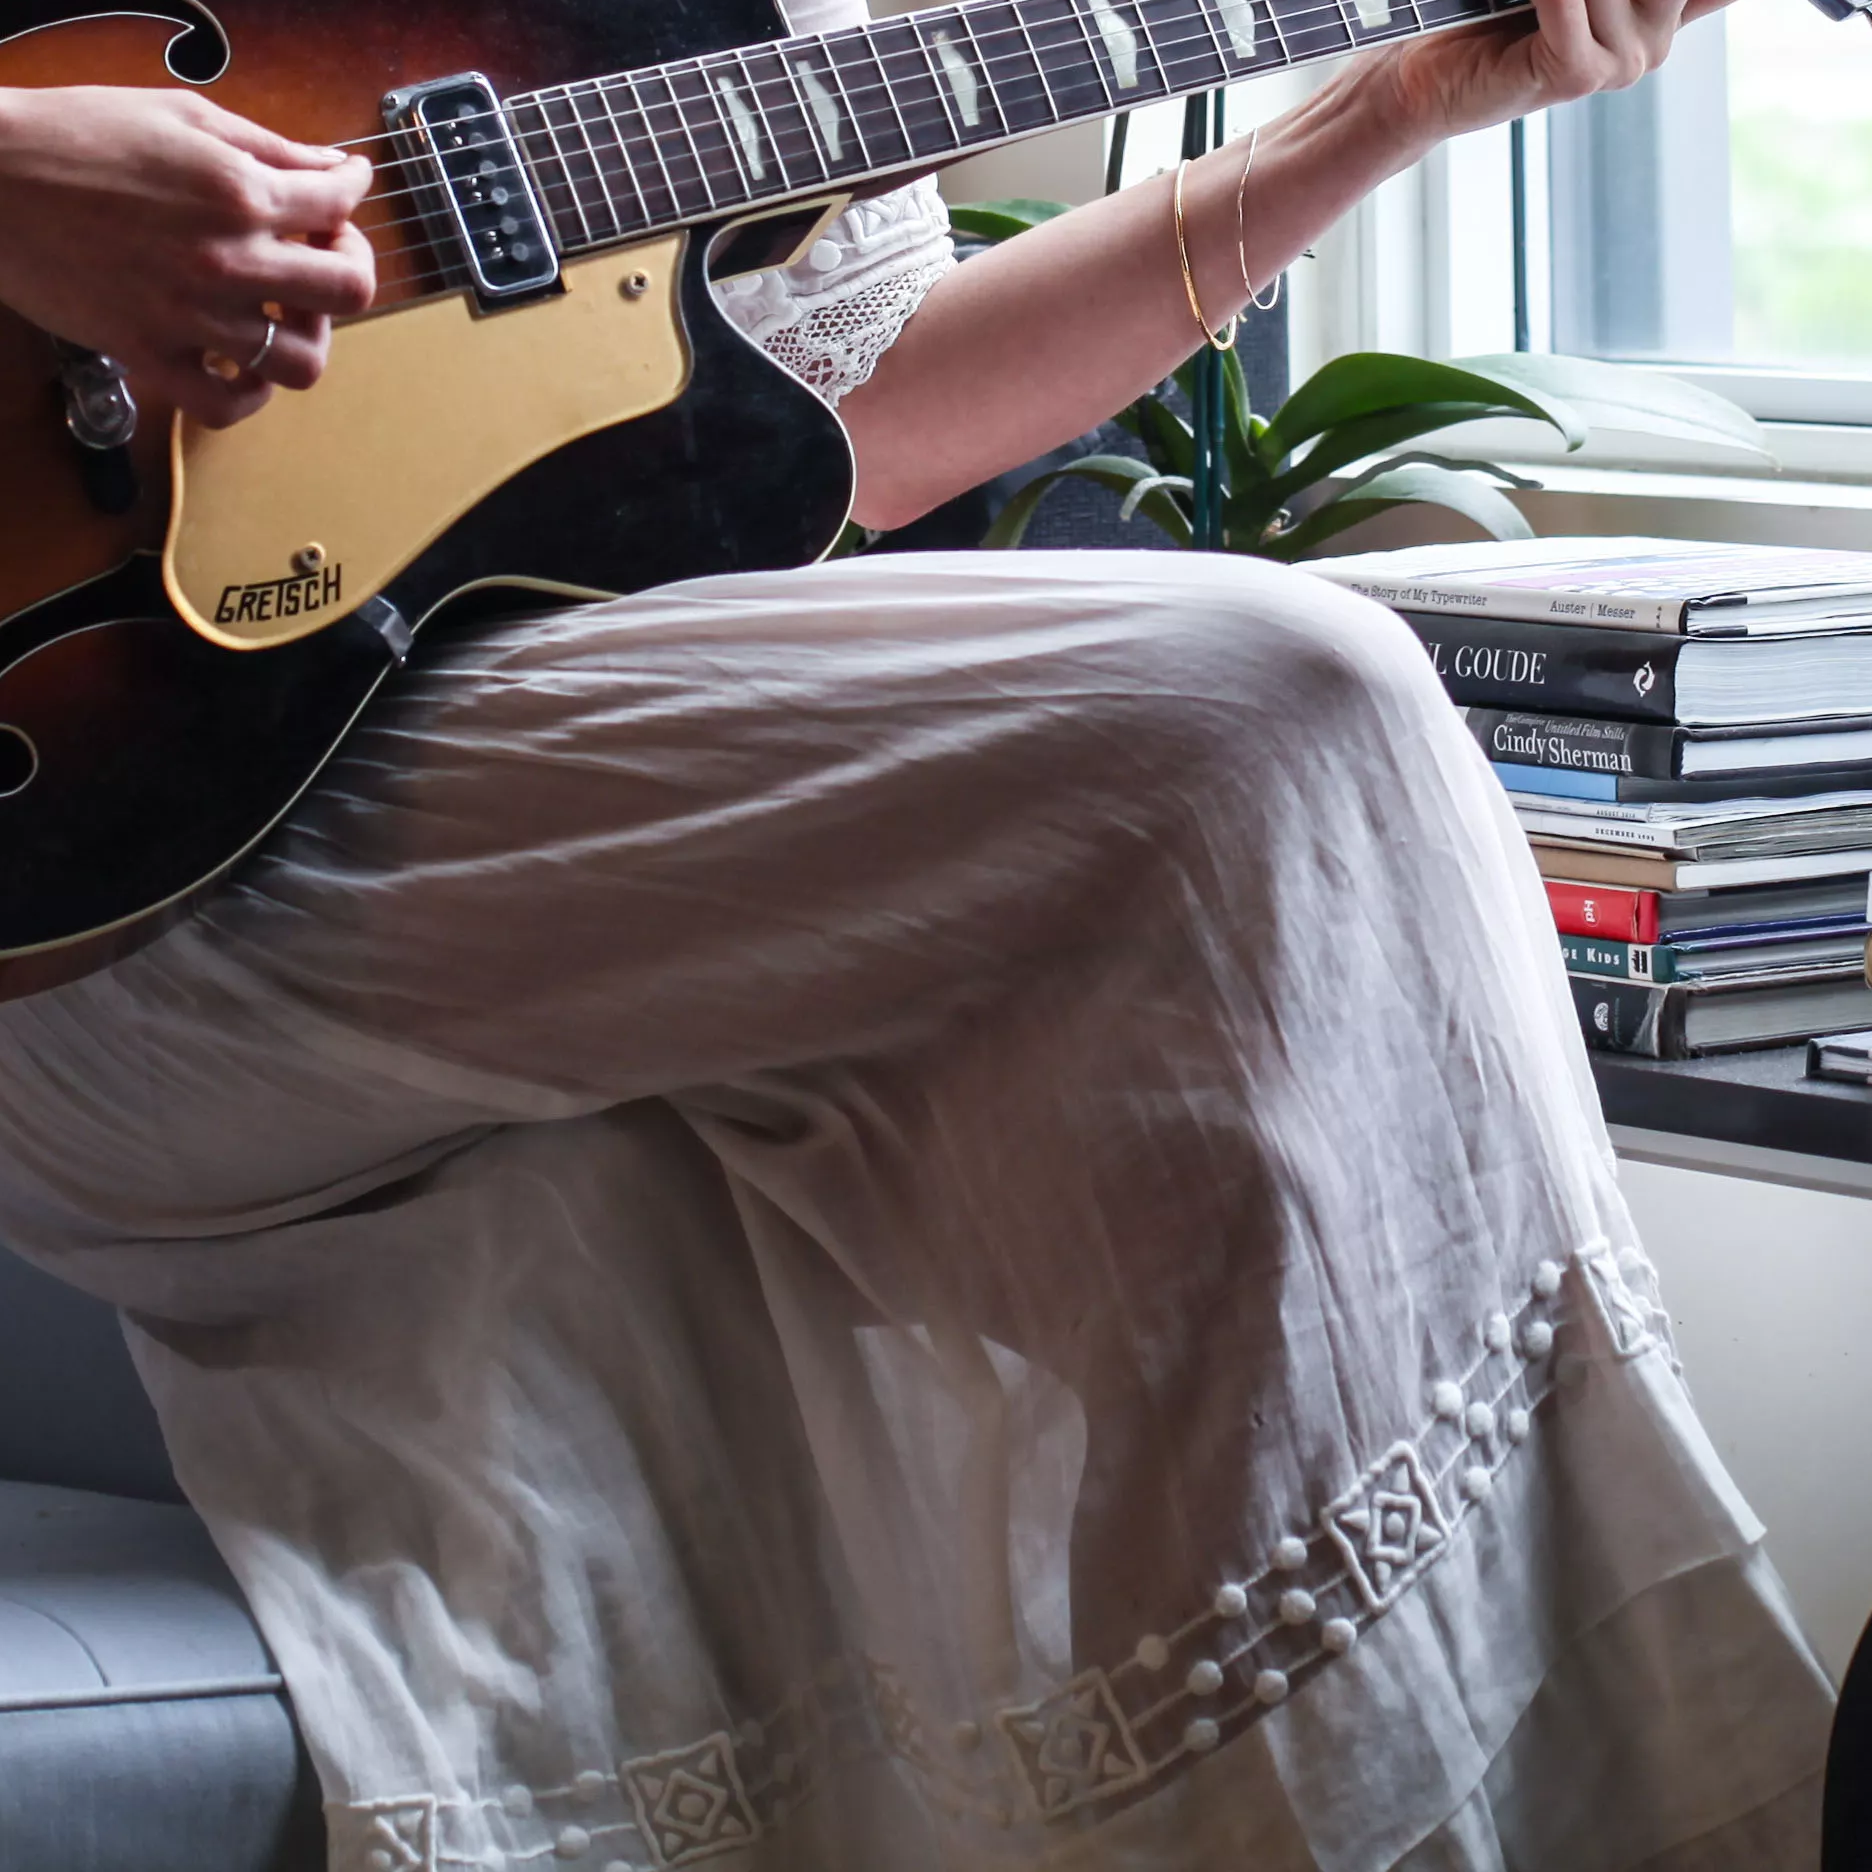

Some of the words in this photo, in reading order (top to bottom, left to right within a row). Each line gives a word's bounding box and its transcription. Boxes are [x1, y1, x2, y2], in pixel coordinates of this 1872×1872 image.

[214, 562, 342, 624] GRETSCH
[1351, 583, 1369, 597] The
[1370, 584, 1398, 601] Story
[1399, 587, 1412, 600] of
[1413, 588, 1428, 603] My
[1431, 590, 1488, 606] Typewriter
[1549, 600, 1587, 615] Auster
[1597, 603, 1636, 619] Messer
[1454, 643, 1547, 685] GOUDE
[1545, 719, 1581, 737] Untitled
[1581, 723, 1603, 739] Film
[1602, 726, 1627, 741] Stills
[1493, 724, 1548, 764] Cindy
[1548, 736, 1633, 773] Sherman
[1595, 827, 1635, 839] DECEMBER
